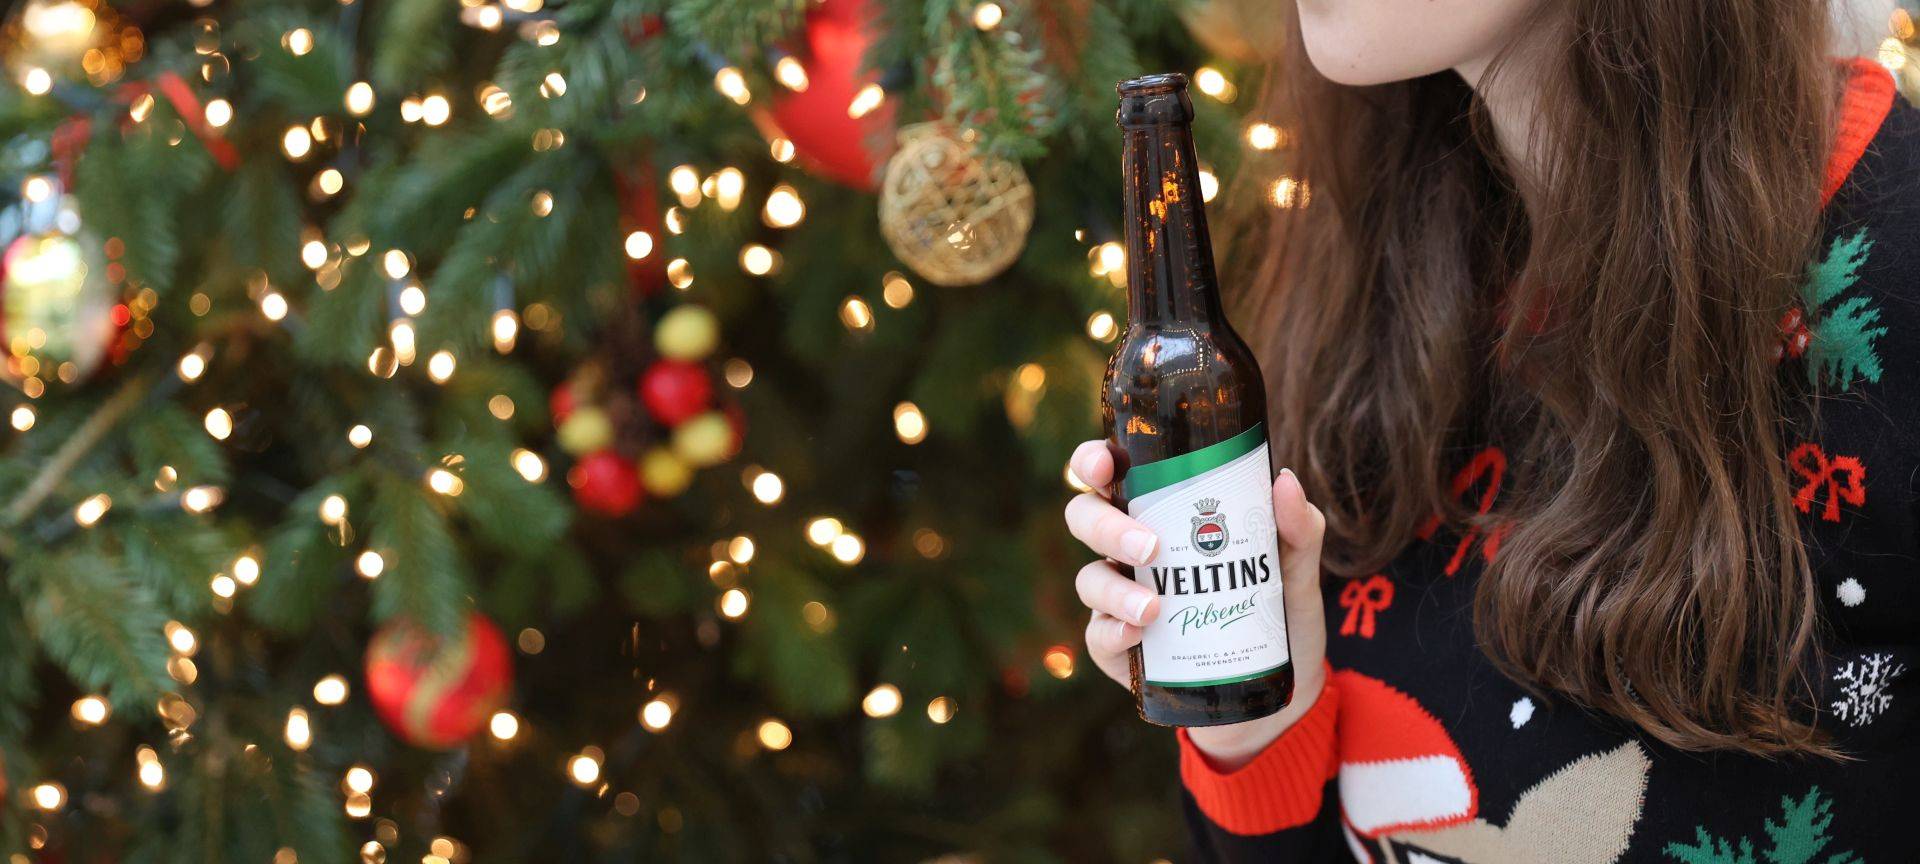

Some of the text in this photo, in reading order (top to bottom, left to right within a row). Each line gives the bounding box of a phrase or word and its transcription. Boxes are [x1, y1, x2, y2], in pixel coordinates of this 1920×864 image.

[1150, 553, 1270, 596] VELTINS
[1168, 591, 1260, 636] Pilsener
[1171, 653, 1211, 661] BRAUEREI
[1240, 643, 1268, 654] VELTINS
[1195, 656, 1250, 667] GREVENSTEIN
